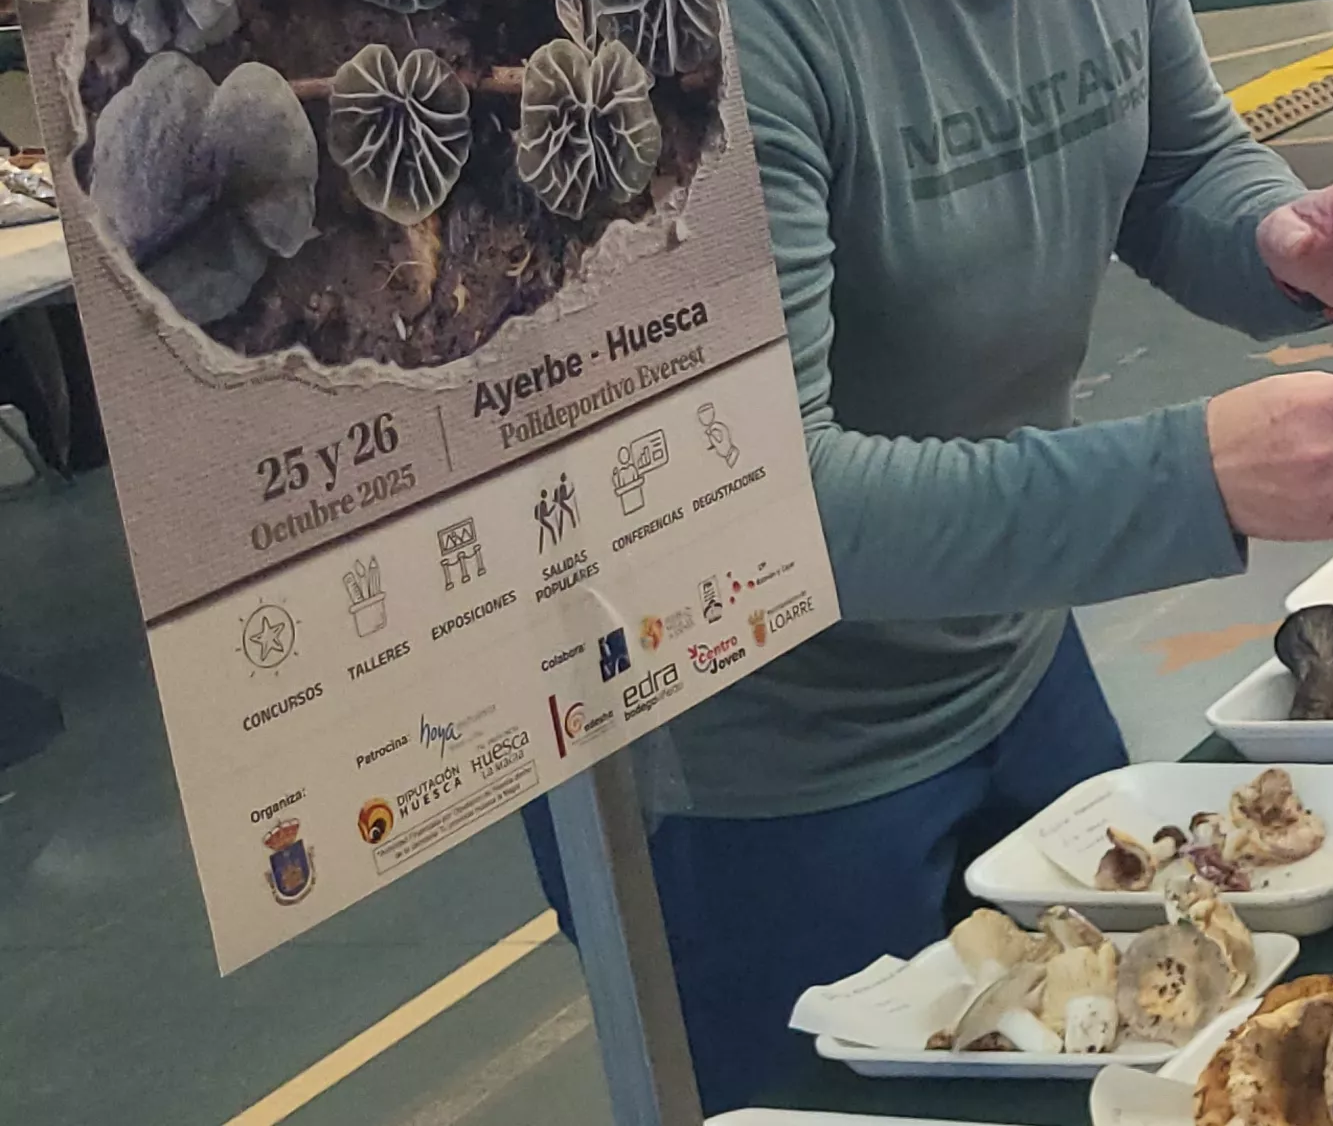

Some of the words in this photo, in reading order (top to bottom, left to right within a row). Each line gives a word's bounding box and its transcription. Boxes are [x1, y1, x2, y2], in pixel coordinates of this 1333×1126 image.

[899, 27, 1146, 170] MOUNTAN
[473, 348, 584, 419] Ayerbe
[606, 299, 709, 363] Huesca
[499, 374, 637, 451] Polideportivo
[637, 343, 707, 392] Everest
[256, 446, 310, 502] 25
[314, 443, 343, 492] y
[347, 410, 399, 468] 26
[250, 492, 355, 551] Octubre
[356, 462, 417, 508] 2025
[691, 465, 767, 513] DEGUSTACIONES
[611, 507, 685, 553] CONFERENCIAS
[534, 561, 600, 603] POPULARES
[541, 548, 588, 581] SALIDAS
[430, 589, 518, 643] EXPOSICIONES
[768, 595, 815, 634] LOARRE
[346, 640, 412, 682] TALLERES
[540, 642, 586, 673] Colabora:
[697, 634, 739, 665] centro
[709, 646, 747, 675] Joven
[242, 682, 324, 732] CONCURSOS
[622, 662, 679, 709] edra
[355, 733, 411, 769] Patrocina:
[249, 787, 308, 826] Organiza:
[395, 763, 461, 807] DIPUTACIÓN
